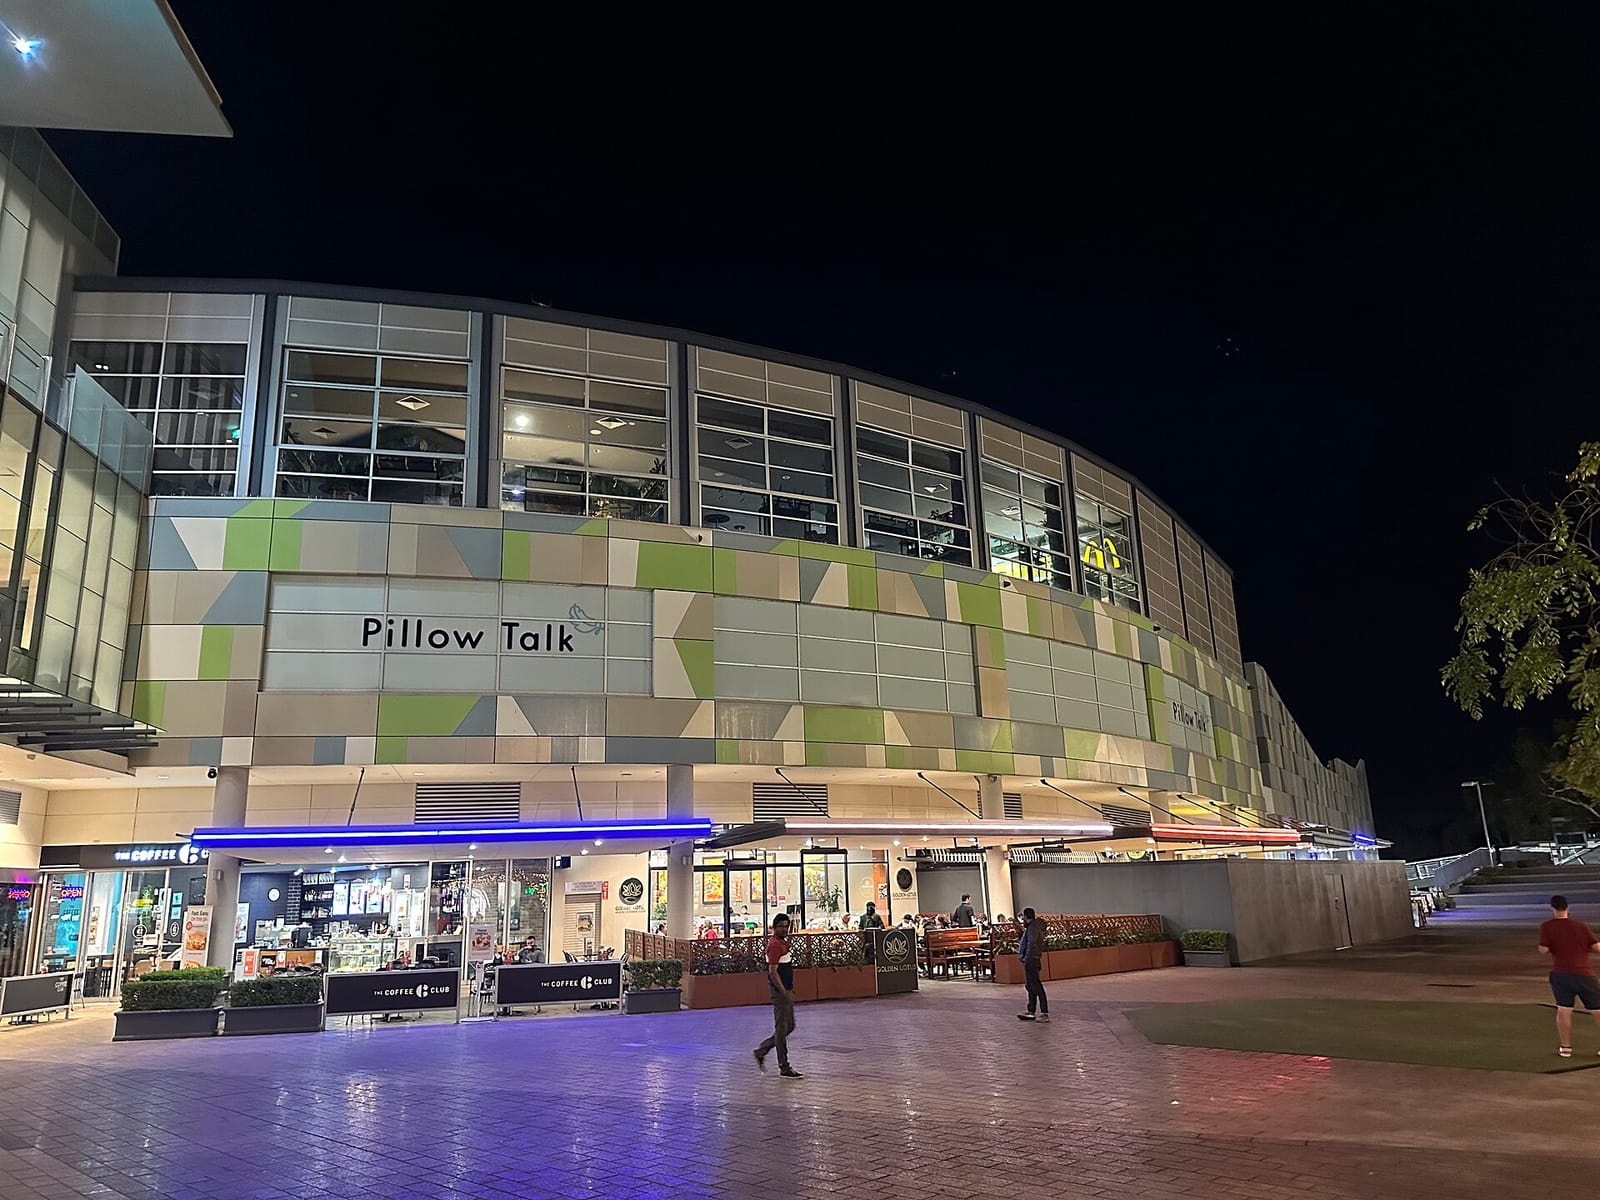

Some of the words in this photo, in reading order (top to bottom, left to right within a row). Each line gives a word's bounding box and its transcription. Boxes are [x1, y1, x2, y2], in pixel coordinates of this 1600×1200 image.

[362, 617, 484, 649] Pillow
[501, 622, 575, 652] Talk
[131, 849, 176, 862] COFFEE
[61, 888, 82, 897] OPEN
[551, 980, 578, 988] COFFEE
[384, 988, 414, 996] COFFEE
[430, 986, 450, 994] CLUB
